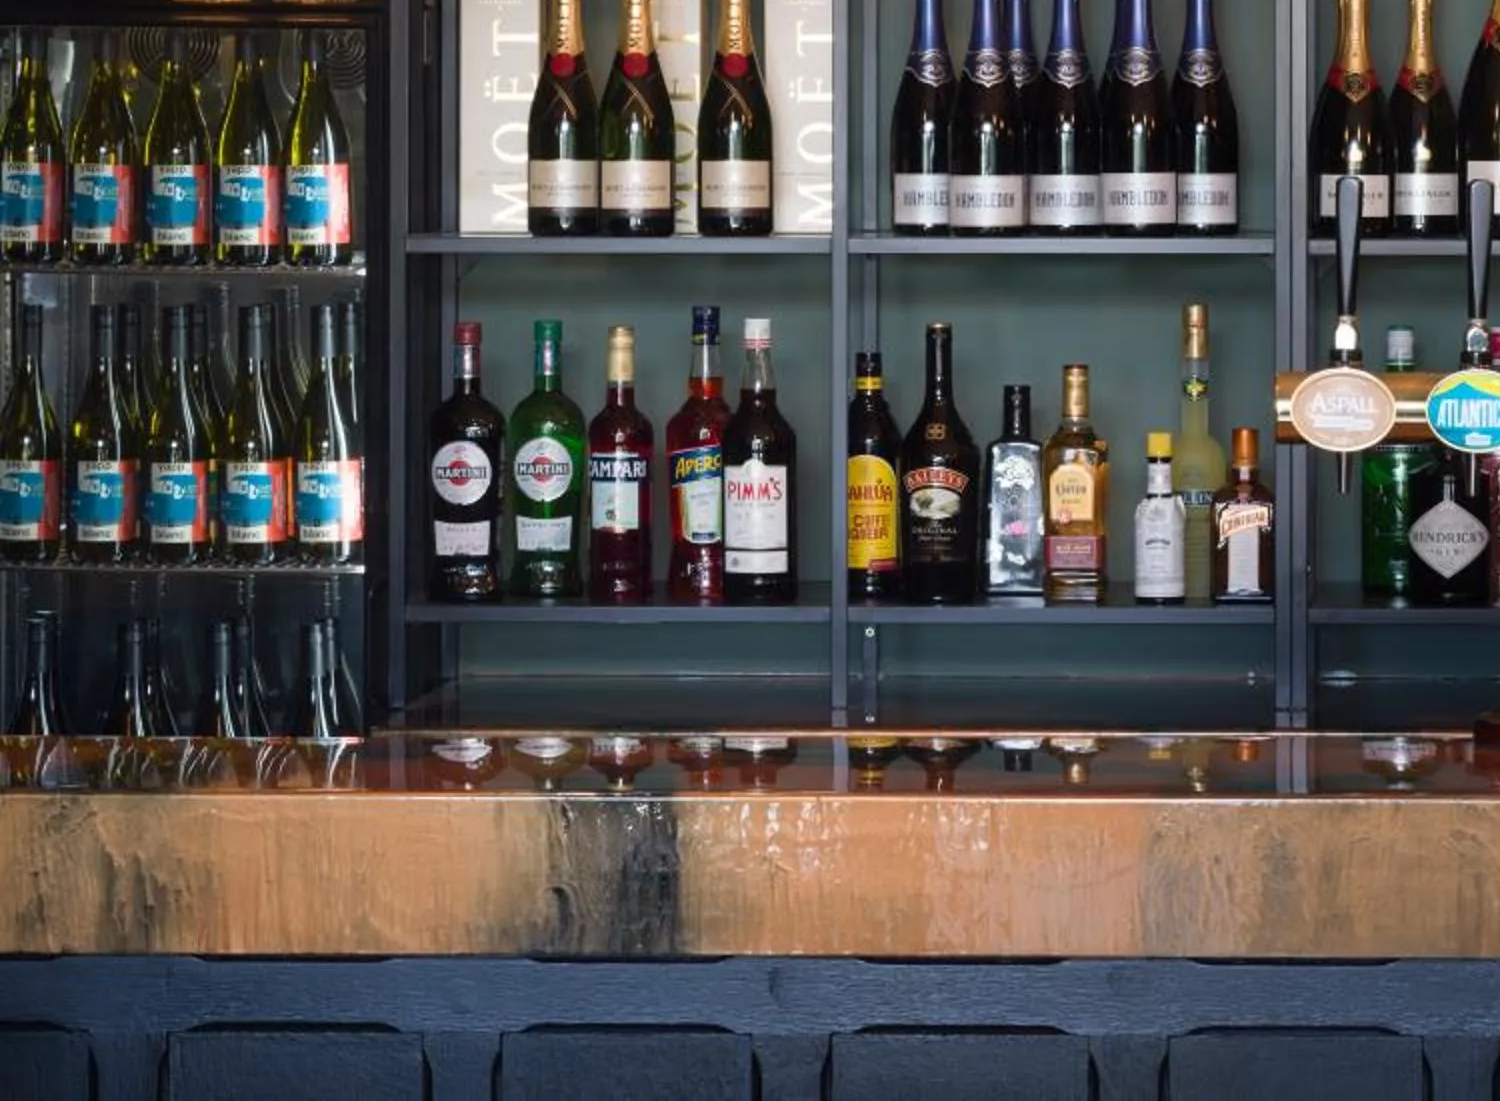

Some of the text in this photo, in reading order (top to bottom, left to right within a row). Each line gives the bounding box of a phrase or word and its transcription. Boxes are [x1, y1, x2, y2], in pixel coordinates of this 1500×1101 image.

[484, 18, 539, 229] MOËT
[788, 19, 833, 225] MOËT
[436, 466, 487, 479] MARTINI
[517, 463, 569, 475] MARTINI
[727, 477, 782, 501] PIMM'S
